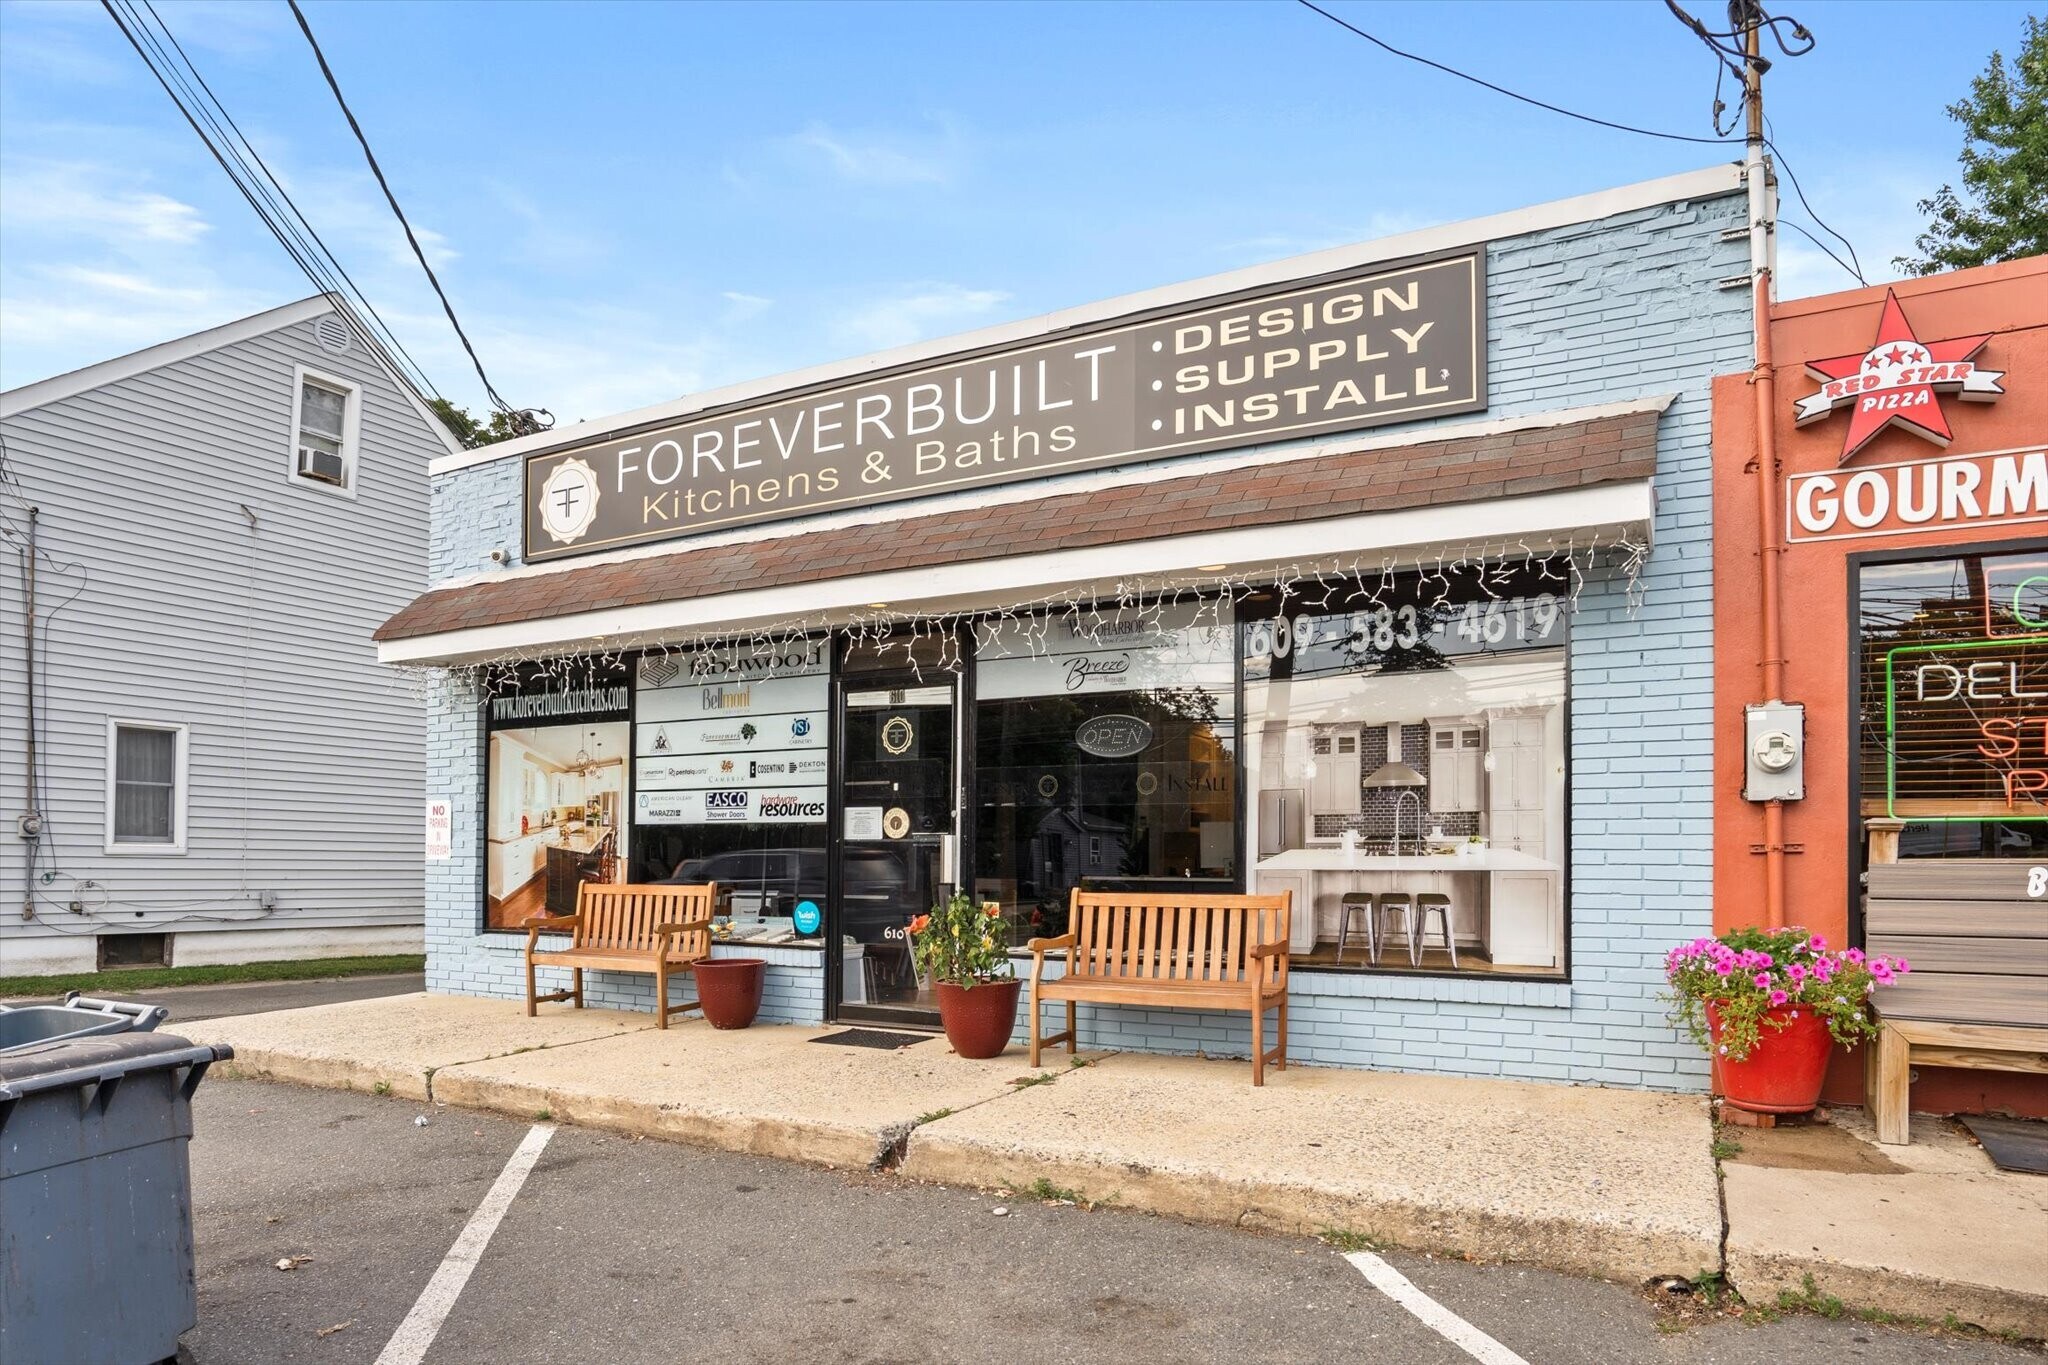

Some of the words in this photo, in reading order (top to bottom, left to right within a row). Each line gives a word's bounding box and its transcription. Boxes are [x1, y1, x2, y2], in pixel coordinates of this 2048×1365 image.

[1175, 281, 1419, 355] DESIGN
[1175, 321, 1435, 394] SUPPLY
[1825, 374, 1881, 399] RED
[1900, 363, 1974, 385] STAR
[1175, 366, 1449, 435] INSTALL
[1861, 389, 1930, 413] PIZZA
[617, 345, 1116, 493] FOREVERBUILT
[643, 467, 839, 524] Kitchens
[861, 450, 893, 484] &
[916, 425, 1077, 476] Baths
[1249, 613, 1314, 659] 609
[1350, 604, 1418, 653] 583
[1456, 592, 1559, 644] 4619
[1062, 652, 1131, 691] Breeze
[702, 685, 750, 711] Bellmont
[1082, 727, 1144, 746] OPEN
[757, 763, 785, 774] COSENTINO
[798, 760, 826, 768] DEKTON
[432, 805, 445, 816] NO
[706, 792, 747, 807] EASCO
[759, 802, 825, 817] resources
[649, 809, 676, 817] MARAZZI
[729, 810, 746, 818] Doors
[883, 926, 905, 941] 610
